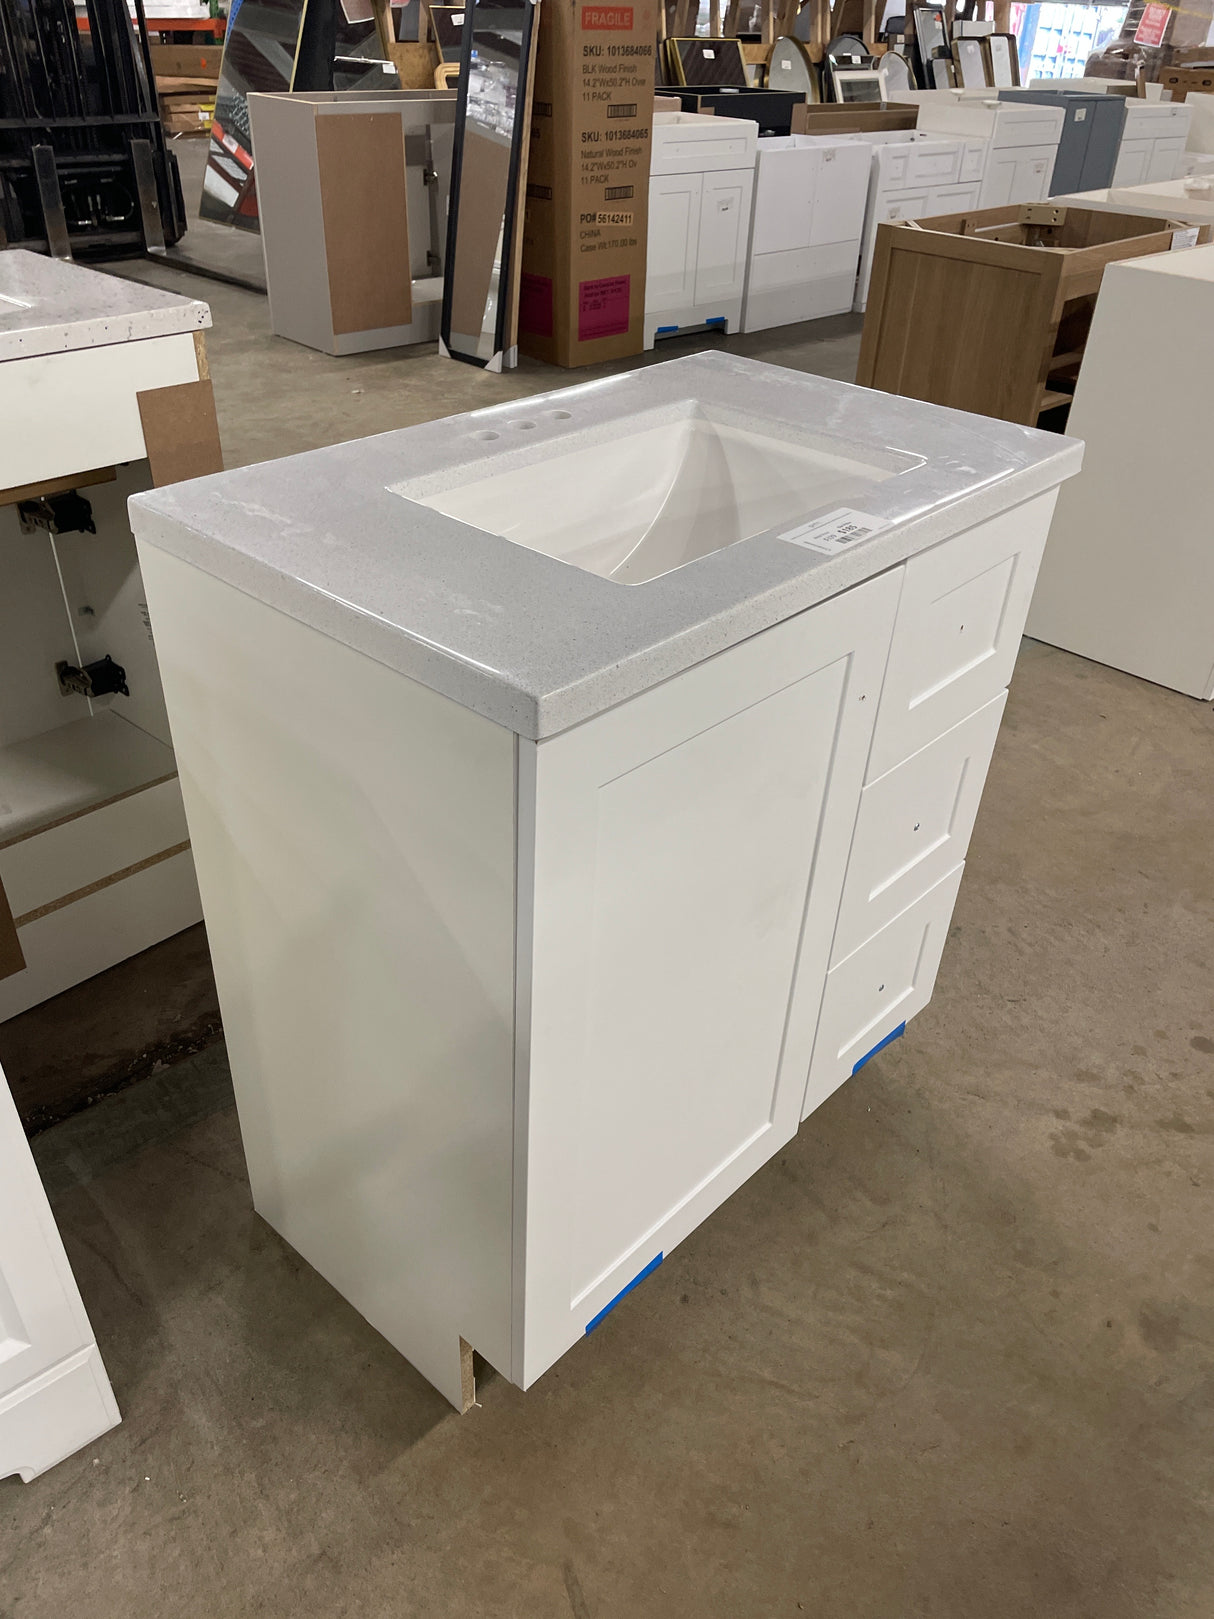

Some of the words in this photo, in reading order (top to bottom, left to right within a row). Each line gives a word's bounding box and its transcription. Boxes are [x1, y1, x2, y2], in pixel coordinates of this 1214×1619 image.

[585, 12, 630, 26] FRAGILE
[583, 46, 604, 57] SKU:
[583, 64, 597, 74] BLK
[598, 64, 617, 73] Wood
[619, 63, 637, 73] Finish
[583, 92, 590, 101] 11
[592, 91, 612, 101] PACK
[581, 131, 602, 143] SKU:
[581, 149, 603, 159] Natural
[606, 147, 623, 157] Wood
[625, 146, 642, 156] Finish
[581, 176, 588, 184] 11
[590, 174, 609, 184] PACK
[580, 213, 596, 224] PO#
[580, 229, 601, 240] CHINA
[581, 244, 597, 252] Case
